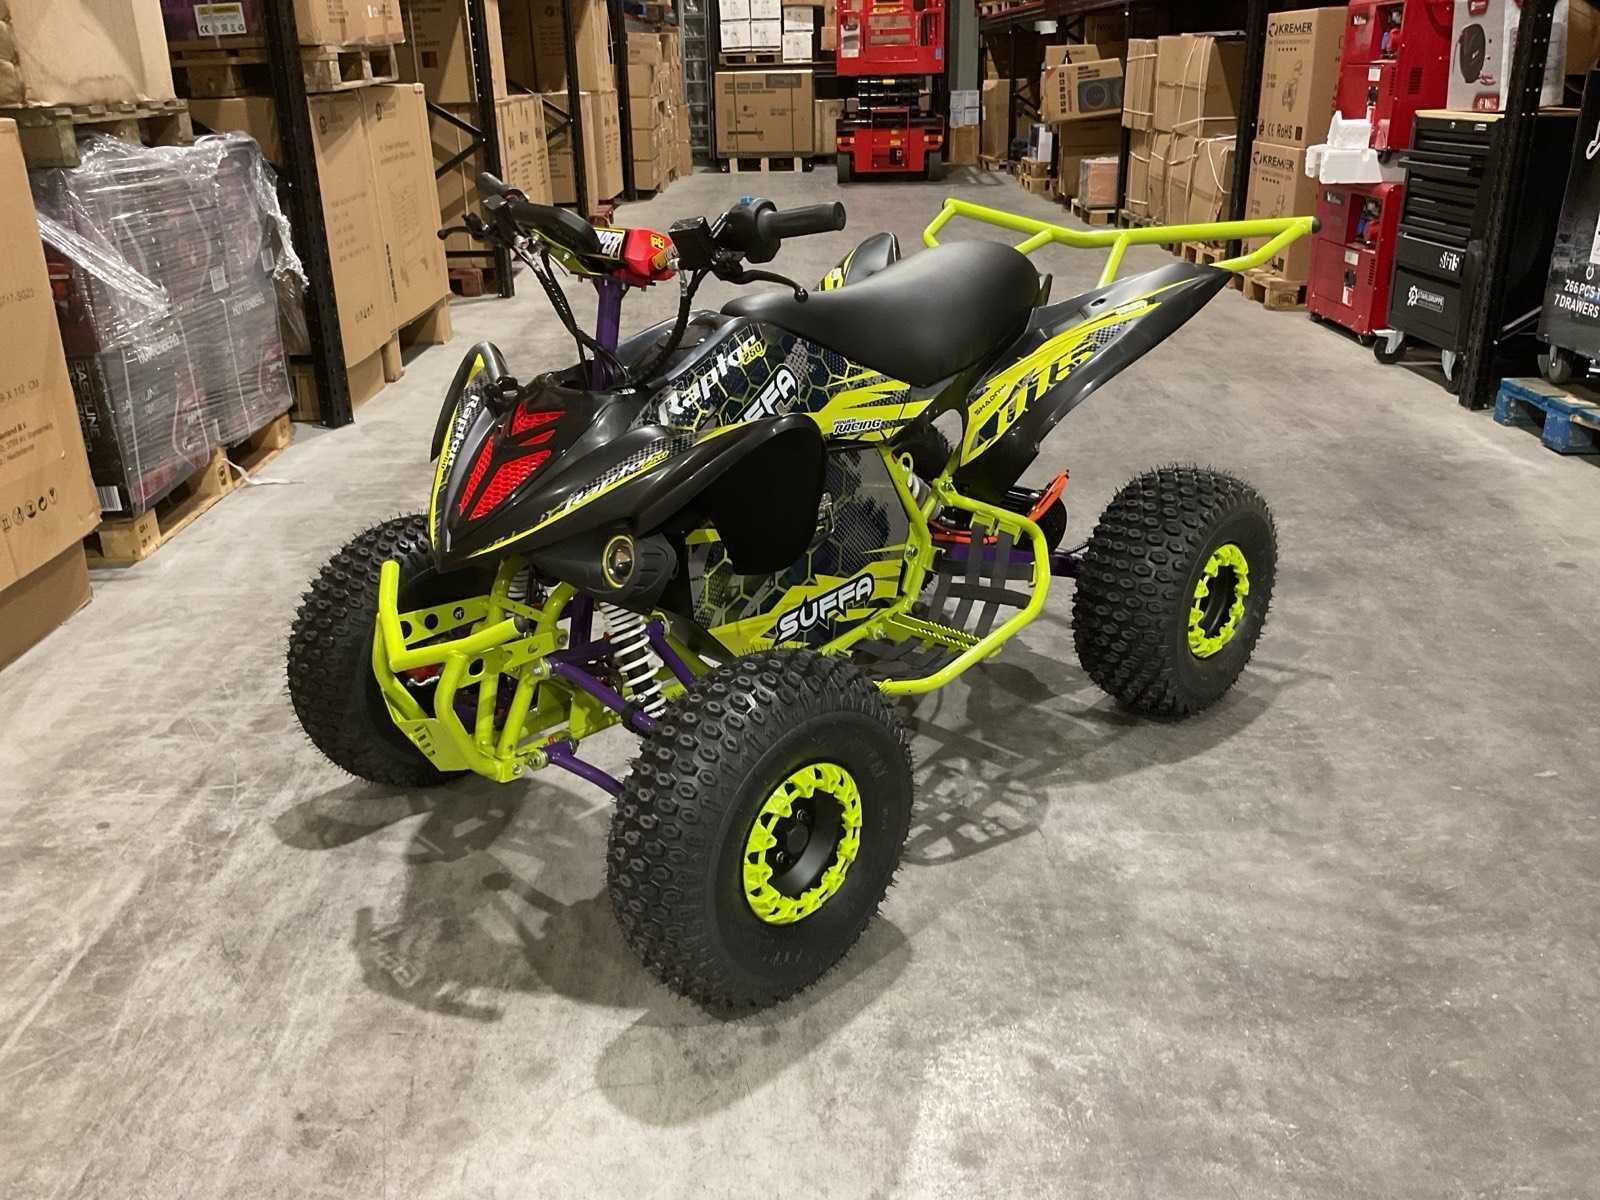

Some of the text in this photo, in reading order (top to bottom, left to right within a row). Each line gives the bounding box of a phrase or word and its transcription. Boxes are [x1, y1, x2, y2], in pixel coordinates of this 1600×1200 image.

[1278, 22, 1313, 34] KREMER
[1276, 123, 1293, 139] RoHS
[1262, 154, 1295, 170] KREMER
[1564, 279, 1579, 294] 266
[1554, 293, 1600, 318] 7 DRAWERS
[658, 333, 763, 426] Raptor 250
[833, 419, 882, 435] RACING
[778, 575, 873, 642] SUFFA
